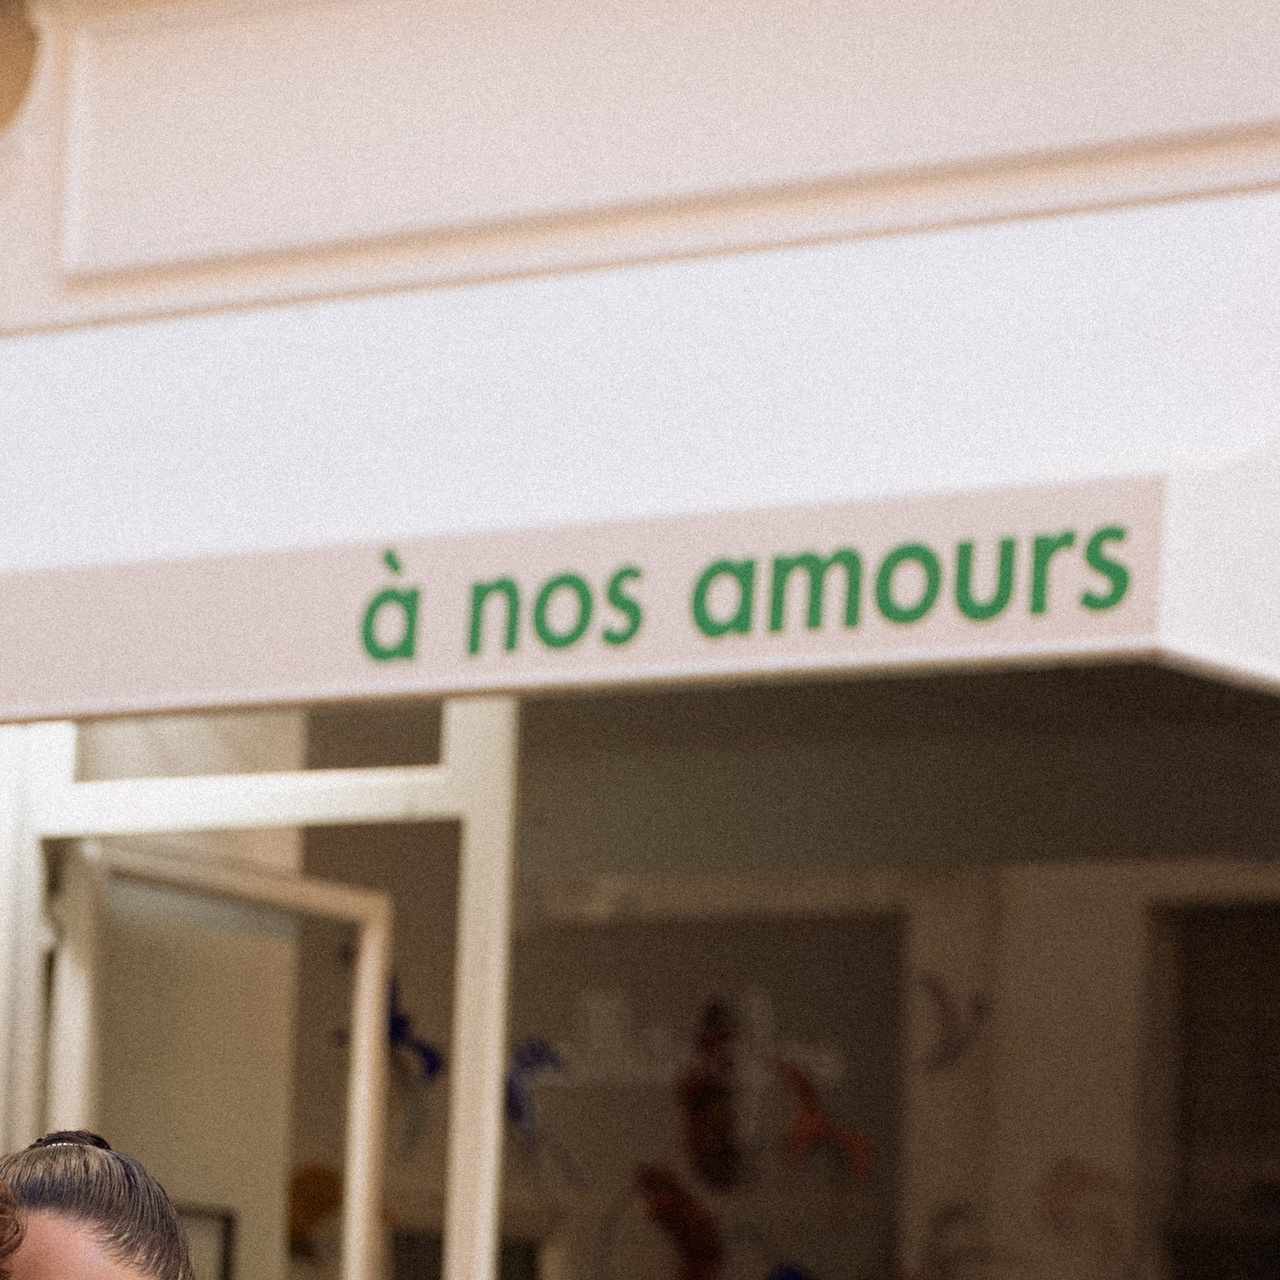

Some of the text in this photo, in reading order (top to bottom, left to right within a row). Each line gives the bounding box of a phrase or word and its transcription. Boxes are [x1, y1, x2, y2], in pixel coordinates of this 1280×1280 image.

[361, 524, 1132, 661] à nos amours
